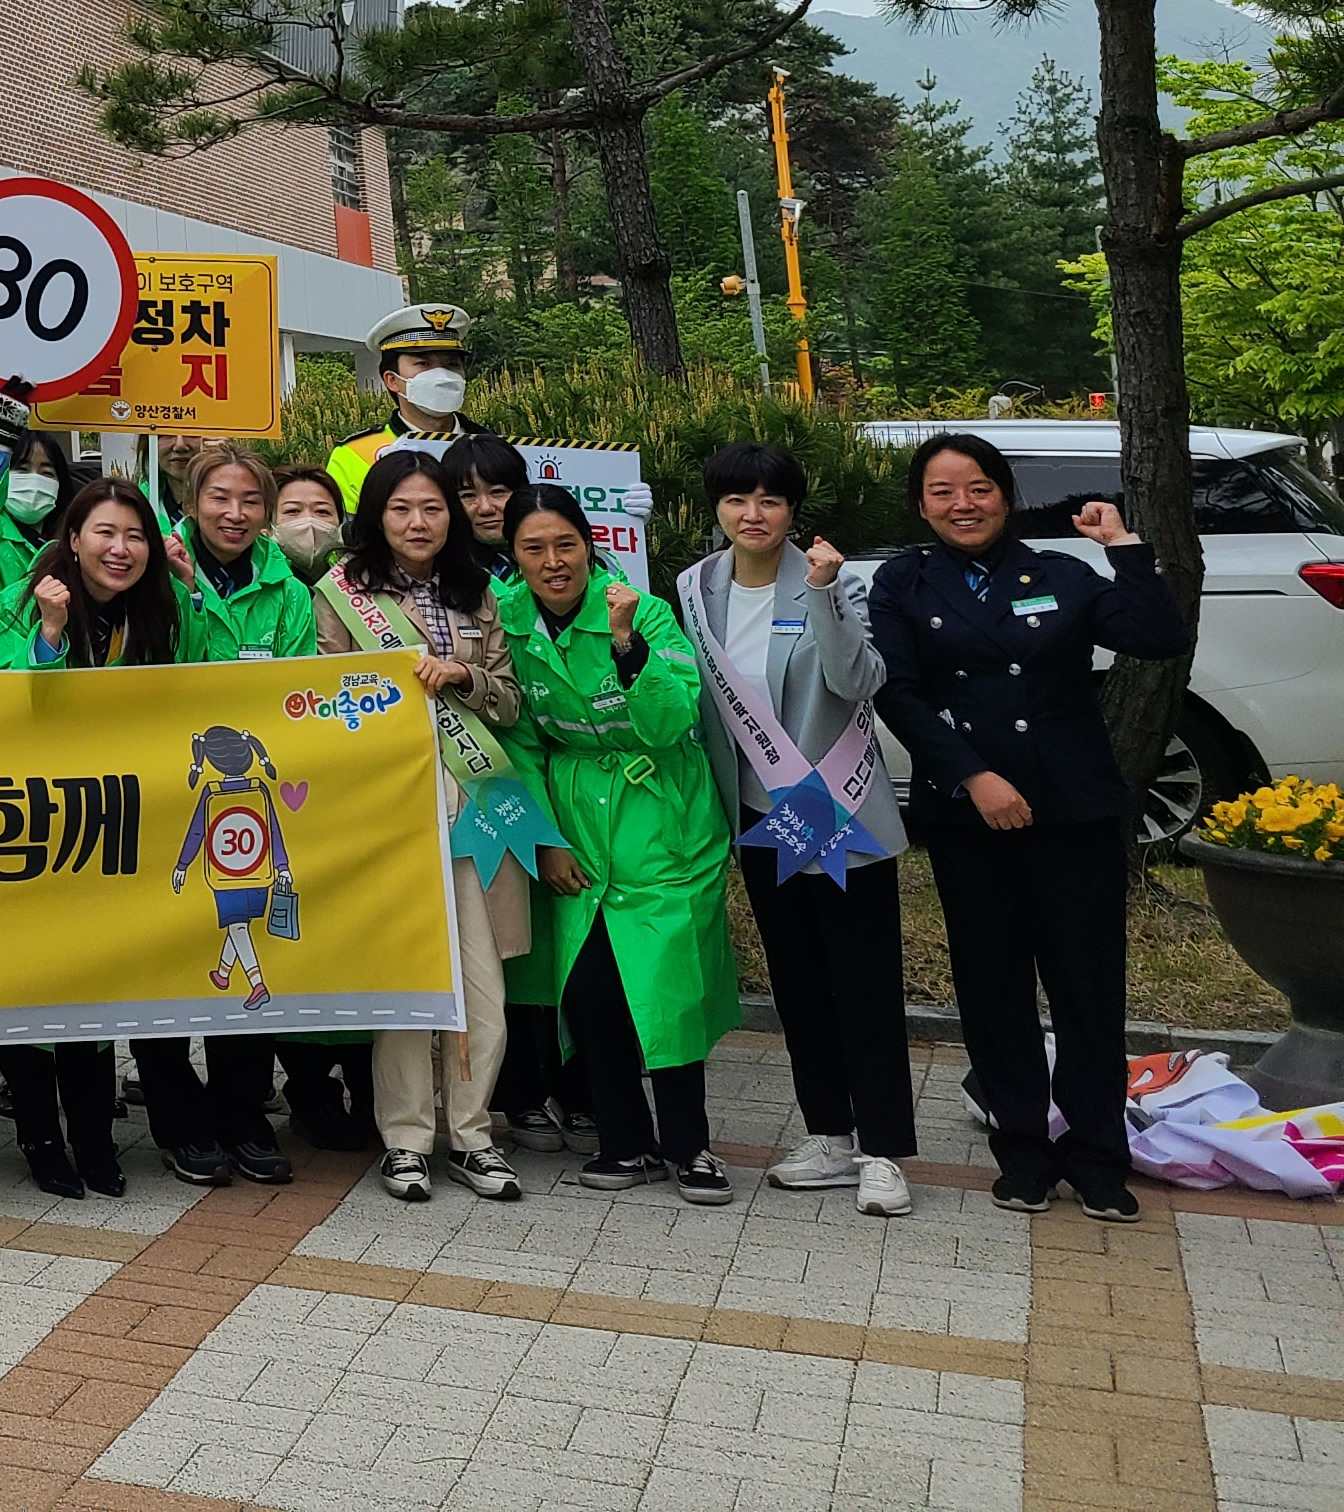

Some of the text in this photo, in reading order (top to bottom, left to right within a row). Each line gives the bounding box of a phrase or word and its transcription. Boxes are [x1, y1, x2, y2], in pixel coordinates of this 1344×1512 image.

[159, 272, 233, 294] 보호구역
[131, 299, 230, 348] 정차
[135, 404, 196, 420] 양산경찰서
[342, 674, 379, 687] 경남교육
[284, 682, 402, 730] 아이좋아
[221, 827, 255, 856] 30
